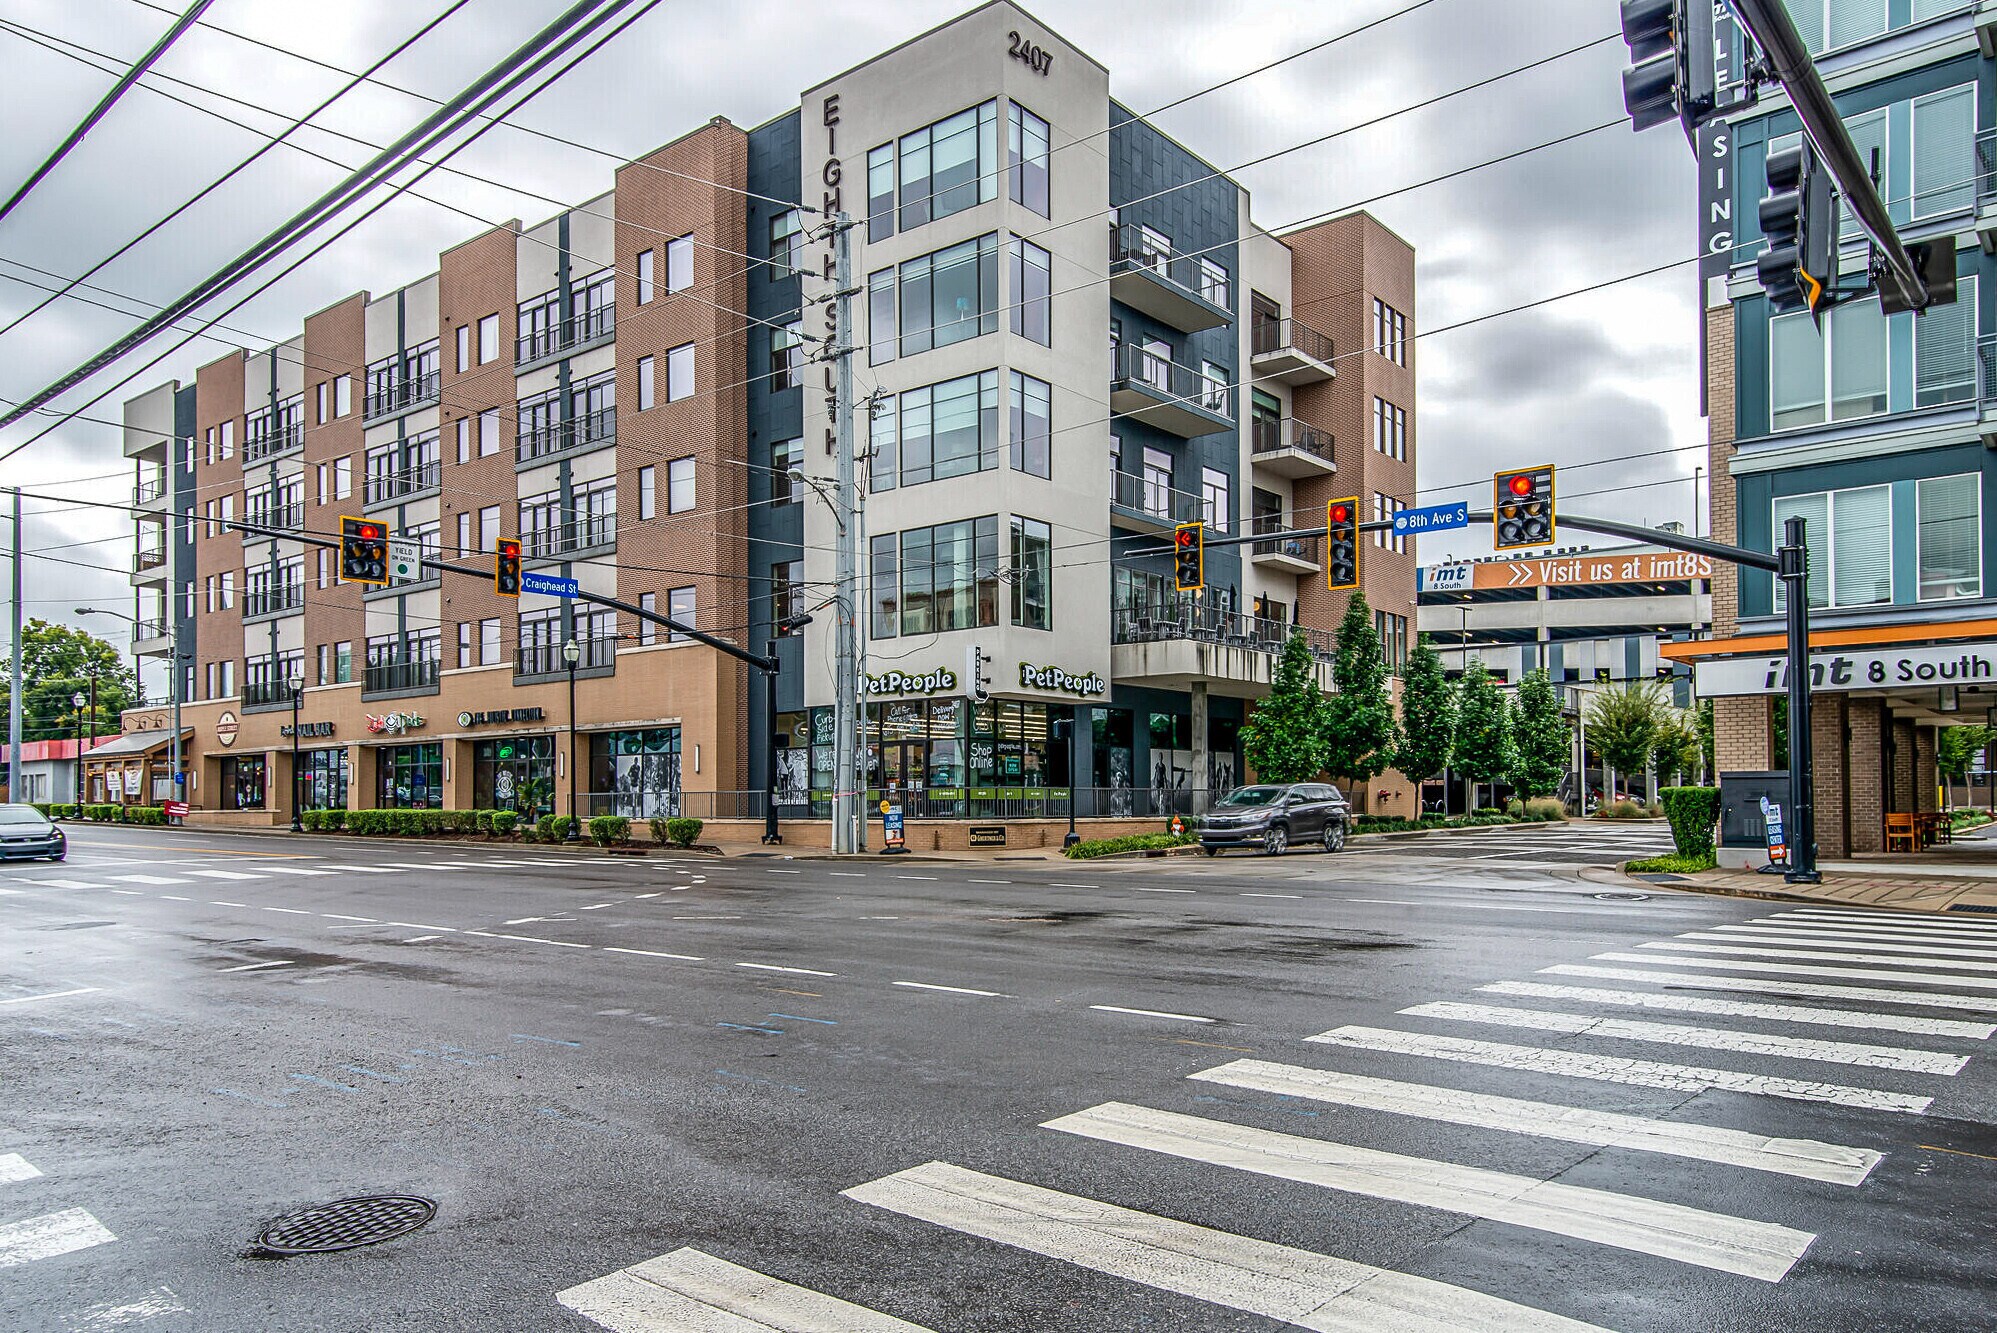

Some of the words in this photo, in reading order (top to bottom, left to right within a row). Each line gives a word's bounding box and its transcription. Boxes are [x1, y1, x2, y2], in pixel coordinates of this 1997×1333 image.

[1008, 30, 1054, 77] 2407
[823, 94, 841, 282] EIGHTH
[1409, 515, 1428, 528] 8th
[1432, 511, 1453, 525] Ave
[1456, 508, 1465, 522] S
[395, 547, 413, 556] YIELD
[400, 556, 415, 564] GREEN
[1429, 566, 1467, 582] imt
[1539, 560, 1582, 583] Visit
[1590, 563, 1613, 582] us
[1621, 557, 1641, 579] at
[525, 577, 566, 593] Craighead
[568, 583, 577, 594] St
[1433, 582, 1439, 590] 8
[1440, 582, 1462, 590] South
[1867, 660, 1887, 684] 8
[1897, 654, 1991, 682] South
[1023, 664, 1106, 695] PetPeople
[970, 742, 993, 760] Shop
